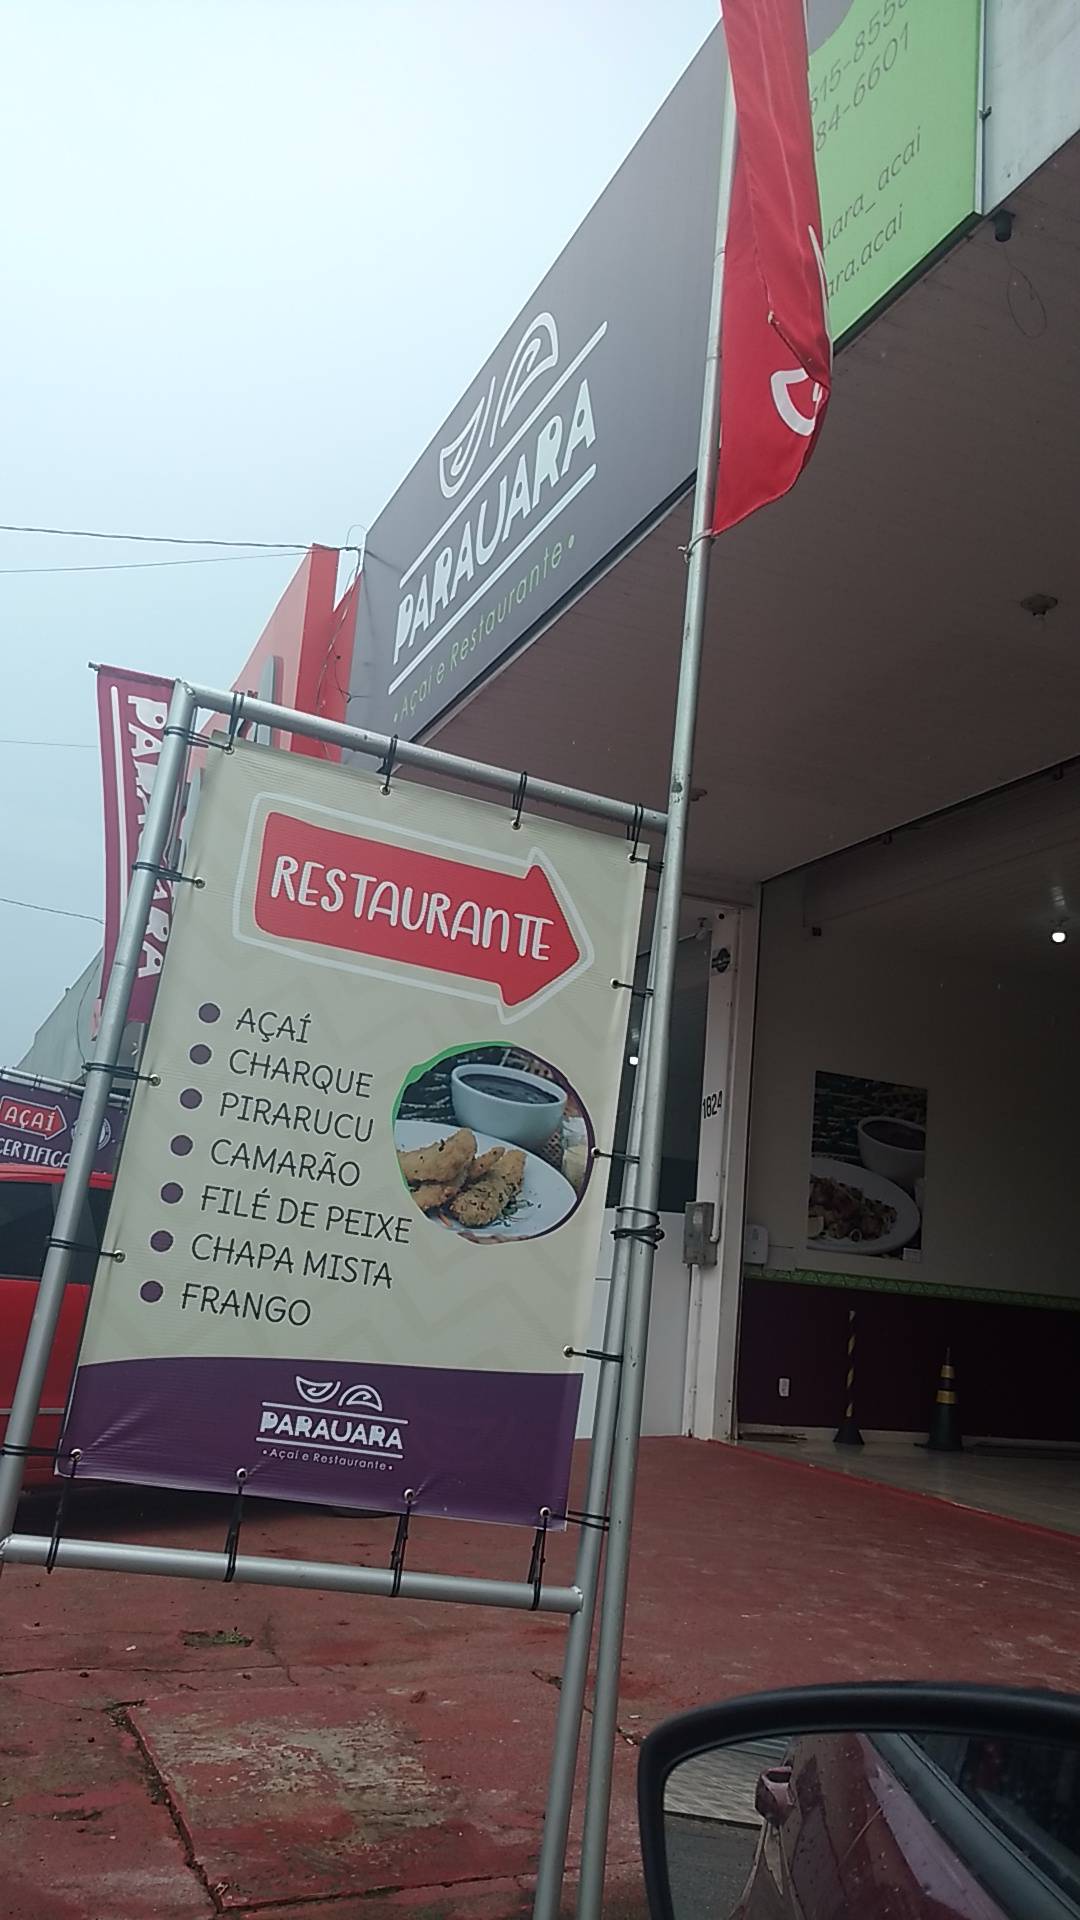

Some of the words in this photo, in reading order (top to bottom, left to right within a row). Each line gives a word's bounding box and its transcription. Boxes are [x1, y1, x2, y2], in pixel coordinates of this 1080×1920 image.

[392, 377, 597, 665] PARAUARA
[436, 662, 446, 684] e
[450, 541, 563, 673] Restaurante
[269, 854, 555, 962] RESTAURANTE
[235, 1006, 312, 1043] AÇAÍ
[228, 1048, 374, 1098] CHARQUE
[4, 1106, 56, 1132] AÇAÍ
[219, 1091, 375, 1143] PIRARUCU
[702, 1090, 723, 1120] 1824
[210, 1138, 361, 1187] CAMARÃO
[200, 1184, 271, 1221] FILÉ
[276, 1197, 320, 1229] DE
[325, 1205, 413, 1244] PEIXE
[191, 1233, 294, 1274] CHAPA
[302, 1250, 393, 1290] MISTA
[181, 1282, 312, 1326] FRANGO
[259, 1411, 404, 1450] PARAUARA
[313, 1452, 387, 1471] Restaurante
